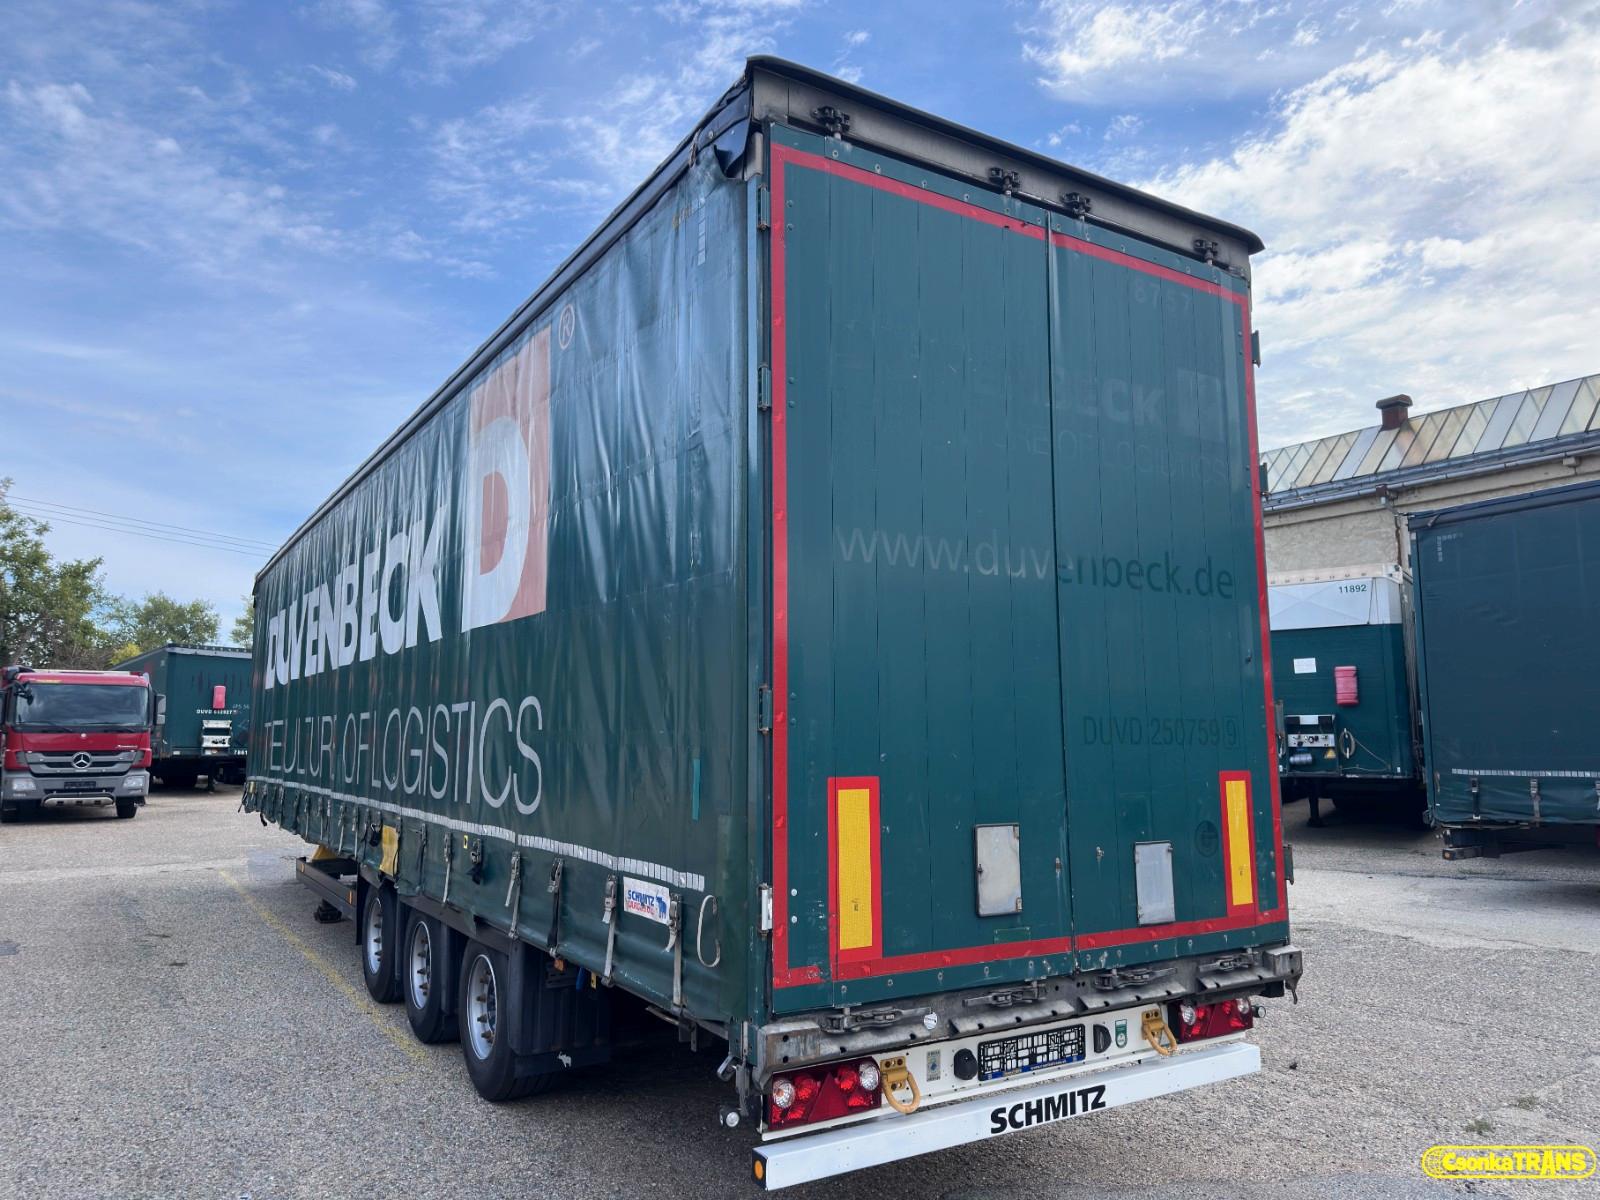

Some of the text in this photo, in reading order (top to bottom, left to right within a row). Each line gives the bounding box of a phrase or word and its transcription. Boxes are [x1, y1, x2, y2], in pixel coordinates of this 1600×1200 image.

[835, 524, 1235, 599] www.duvenbeck.de
[1339, 584, 1367, 593] 11892
[342, 712, 371, 785] OF
[371, 696, 543, 815] LOGISTICS
[1082, 716, 1142, 747] DUVD
[990, 1084, 1106, 1134] SCHMITZ
